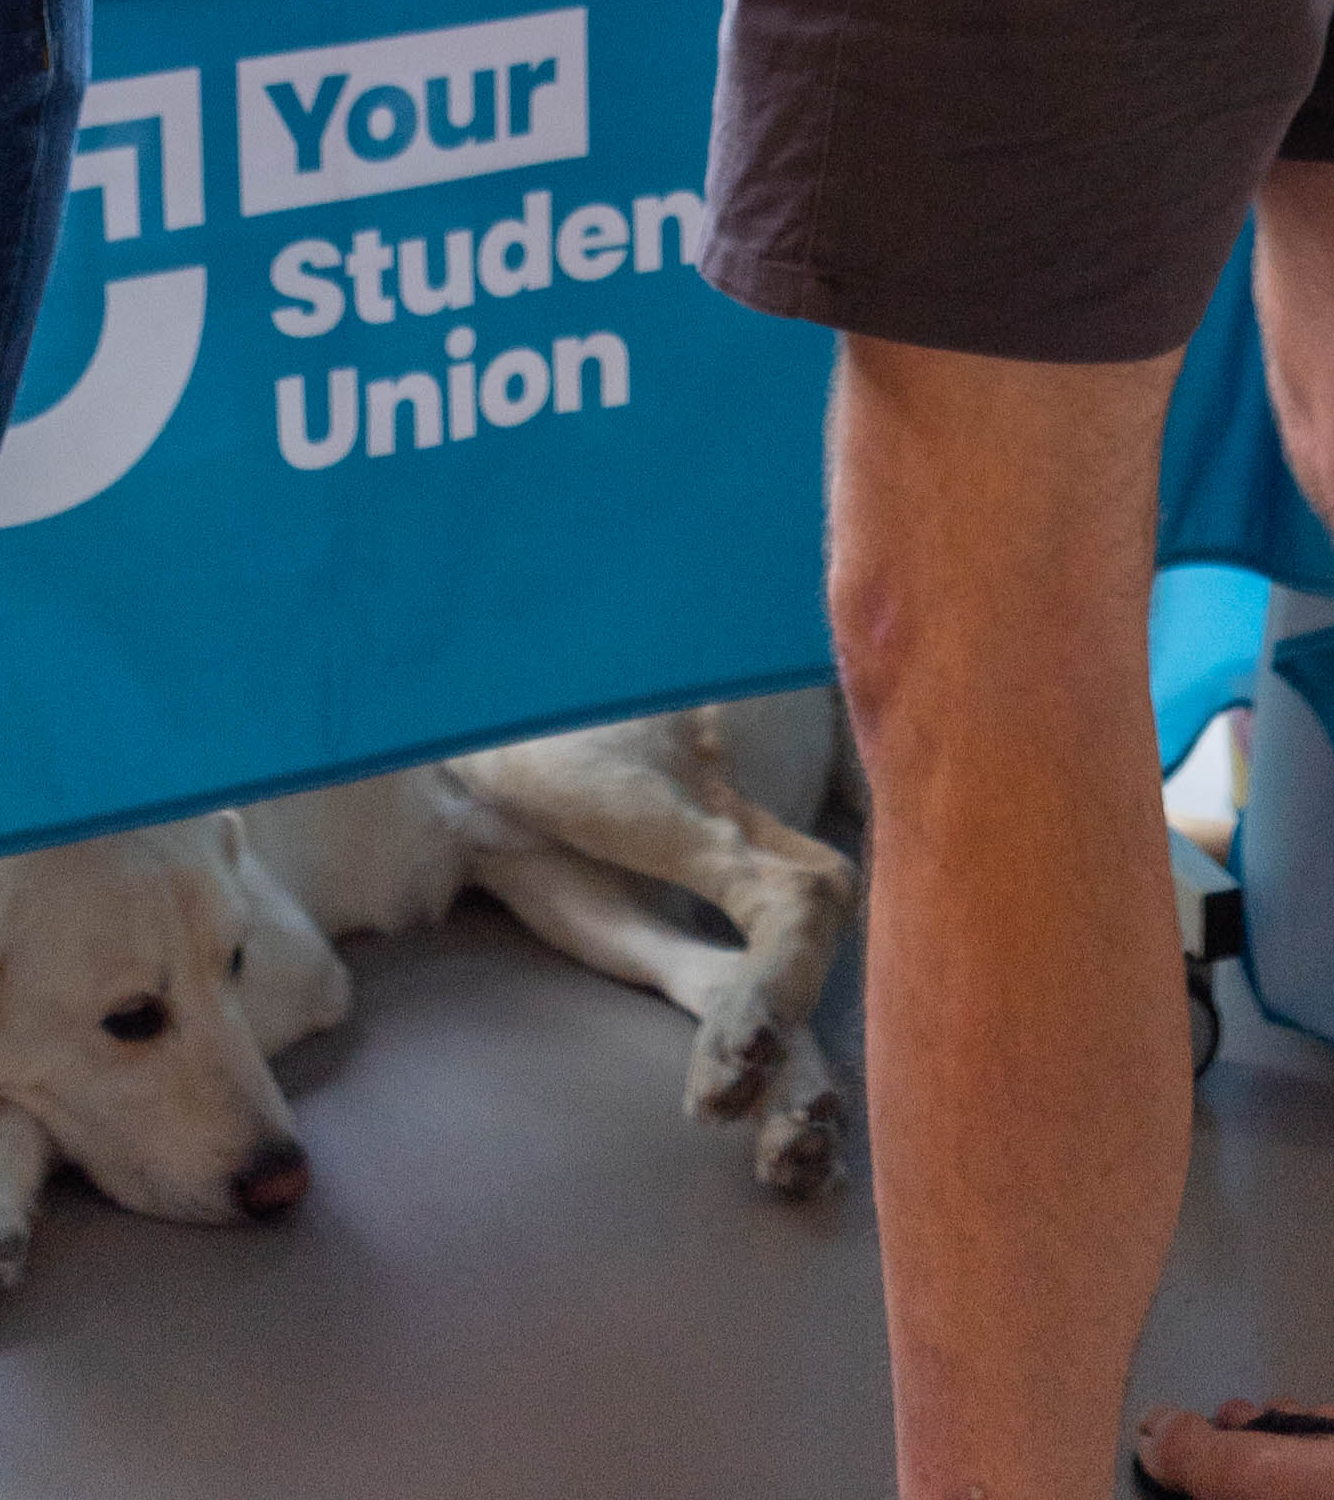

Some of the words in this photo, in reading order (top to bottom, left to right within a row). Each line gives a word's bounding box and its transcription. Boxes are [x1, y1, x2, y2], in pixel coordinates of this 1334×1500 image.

[263, 57, 557, 175] Your
[270, 190, 706, 339] Studen
[274, 327, 631, 471] Union
